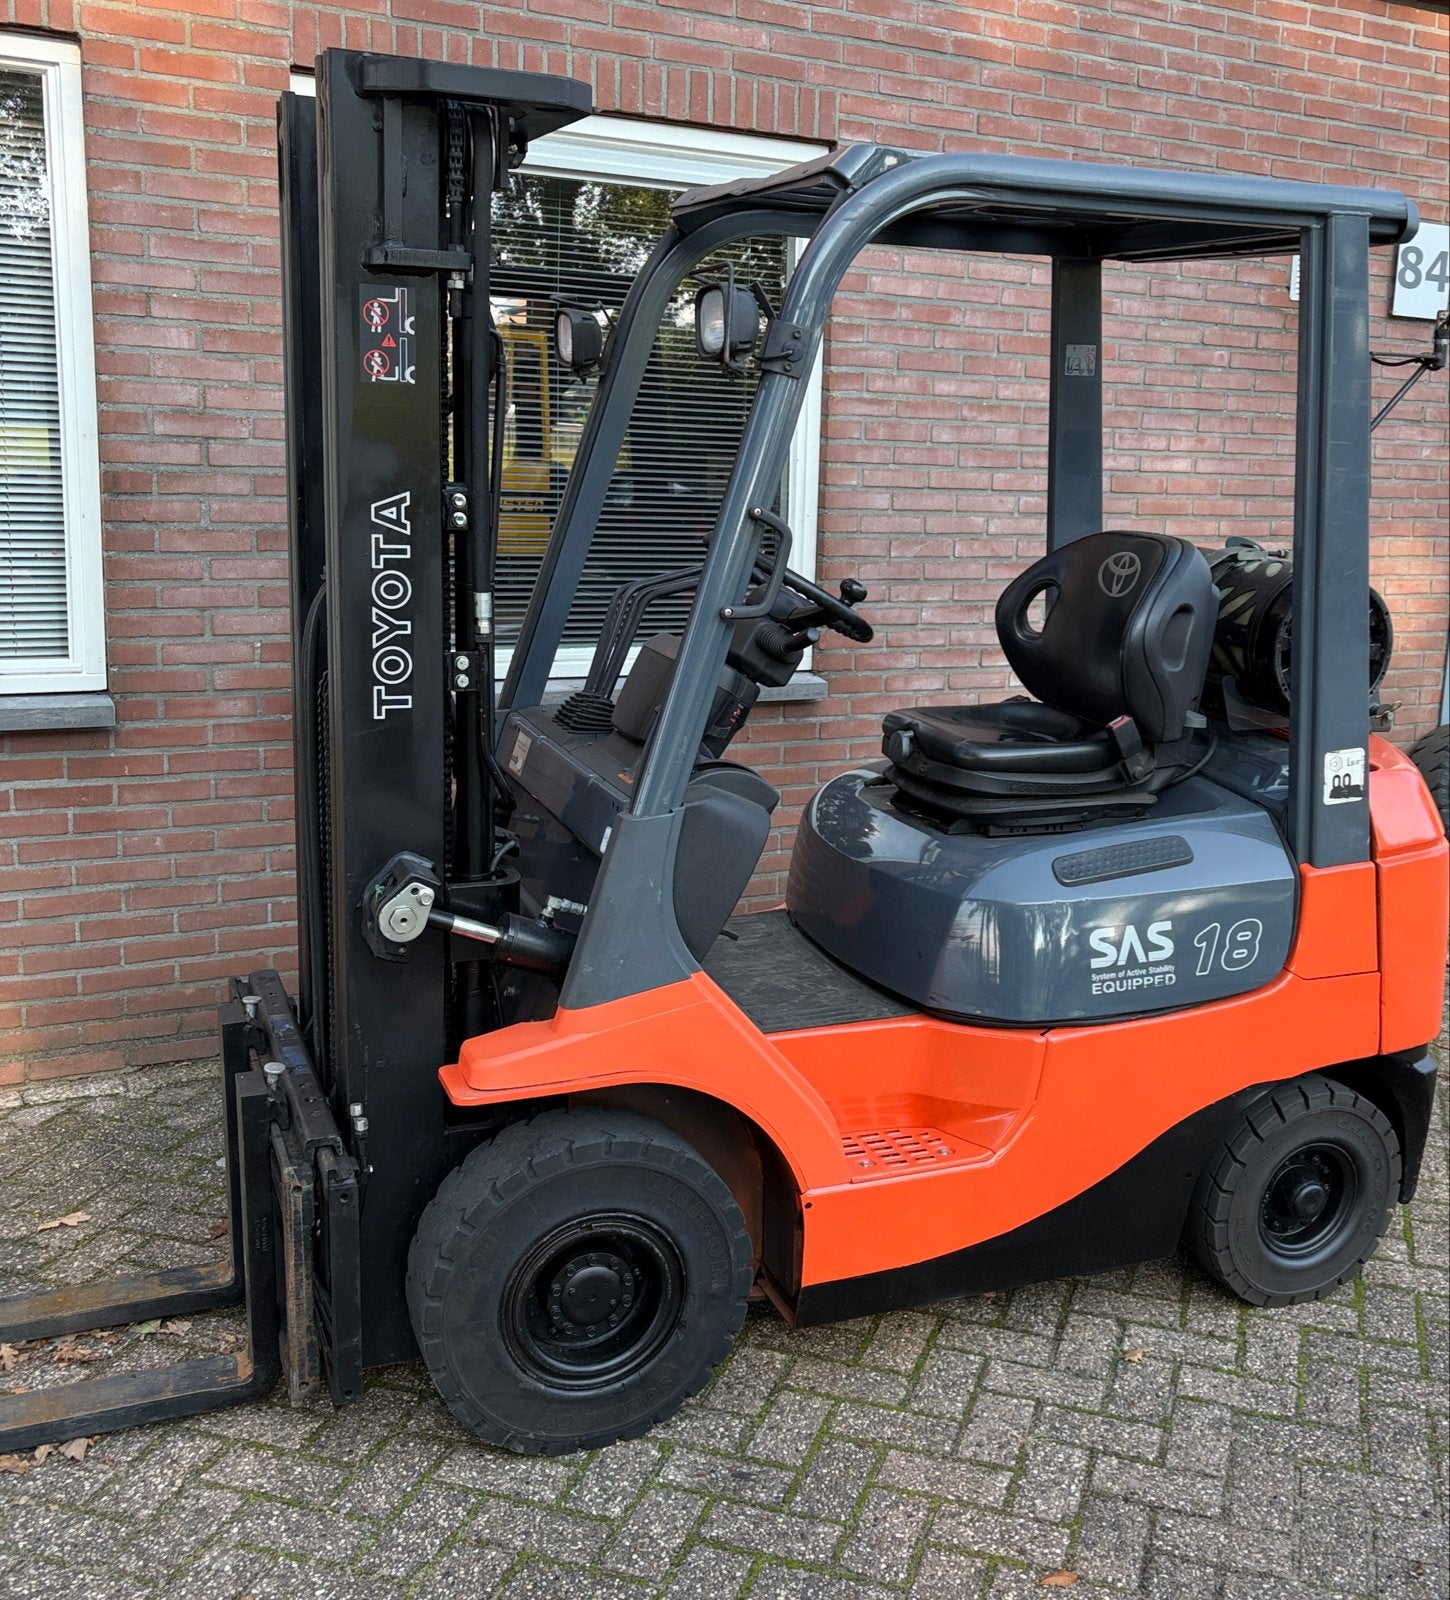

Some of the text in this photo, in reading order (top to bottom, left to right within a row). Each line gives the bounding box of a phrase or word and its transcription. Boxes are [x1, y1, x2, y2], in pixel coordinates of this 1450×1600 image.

[1398, 246, 1449, 292] 84
[371, 491, 412, 720] TOYOTA
[1089, 921, 1174, 969] SAS
[1194, 918, 1262, 976] 18
[1091, 964, 1176, 983] System of Active Stability
[1091, 973, 1177, 995] EQUIPPED
